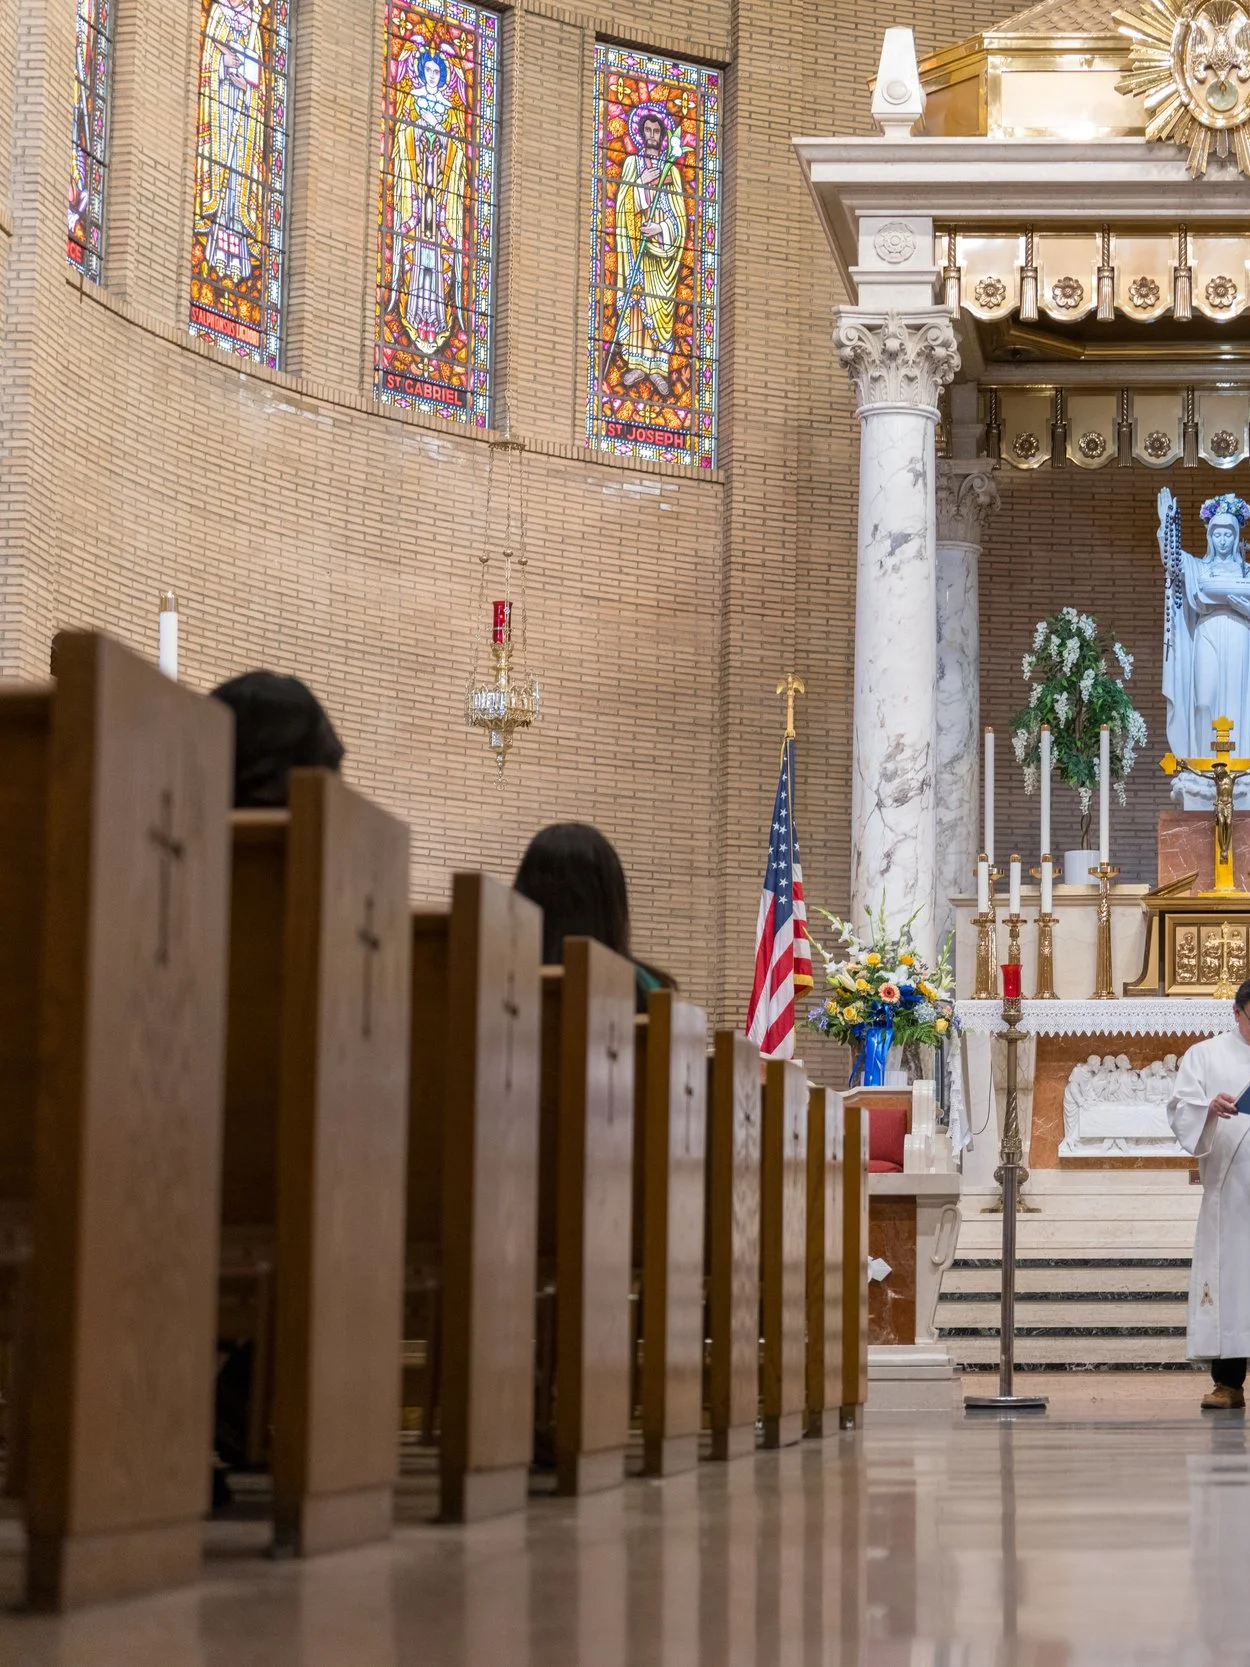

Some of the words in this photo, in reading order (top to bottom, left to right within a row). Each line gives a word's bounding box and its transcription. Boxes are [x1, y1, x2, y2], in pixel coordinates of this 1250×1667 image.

[387, 373, 402, 389] ST
[405, 378, 462, 406] GABRIEL
[608, 423, 622, 437] ST
[627, 427, 685, 449] JOSEPH
